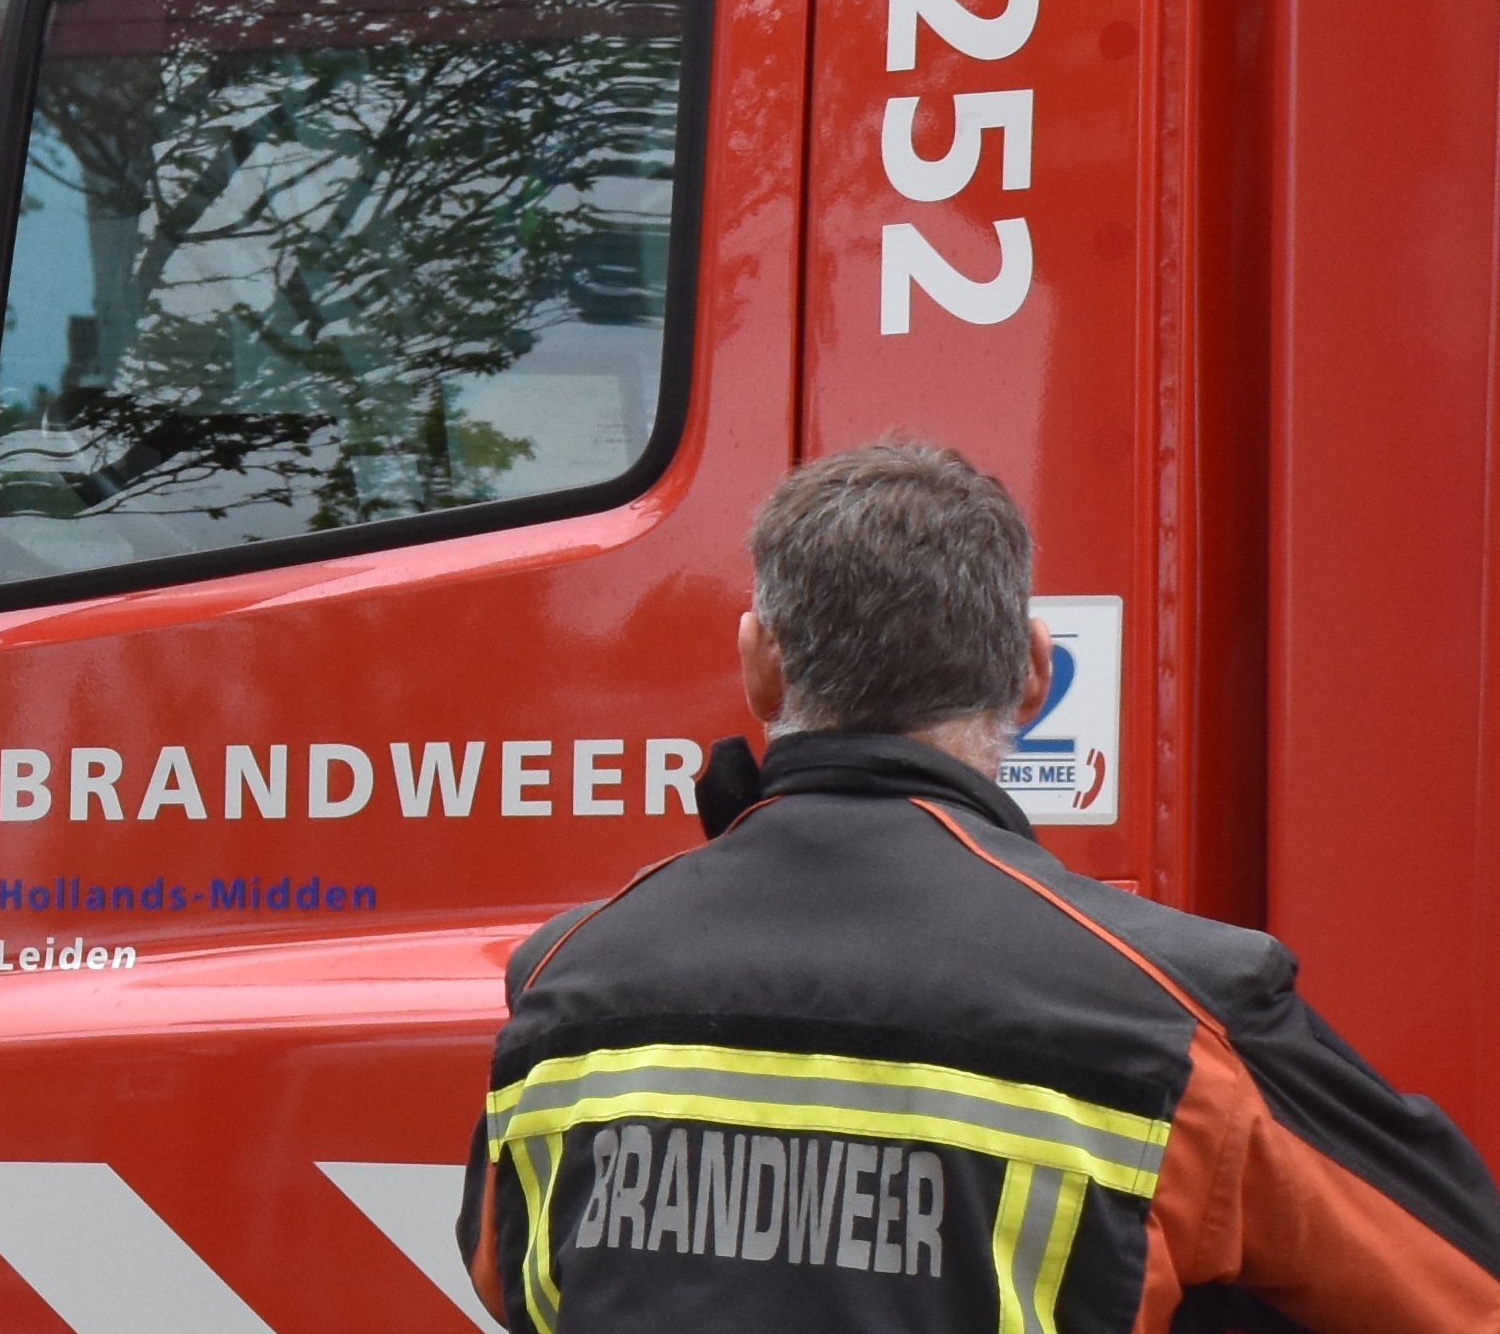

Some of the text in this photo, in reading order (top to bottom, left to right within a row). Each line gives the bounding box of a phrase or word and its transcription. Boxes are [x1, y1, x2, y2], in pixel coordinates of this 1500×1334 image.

[0, 737, 703, 822] BRANDWEER
[1038, 765, 1076, 784] MEE
[575, 1125, 945, 1278] BRANDWEER
